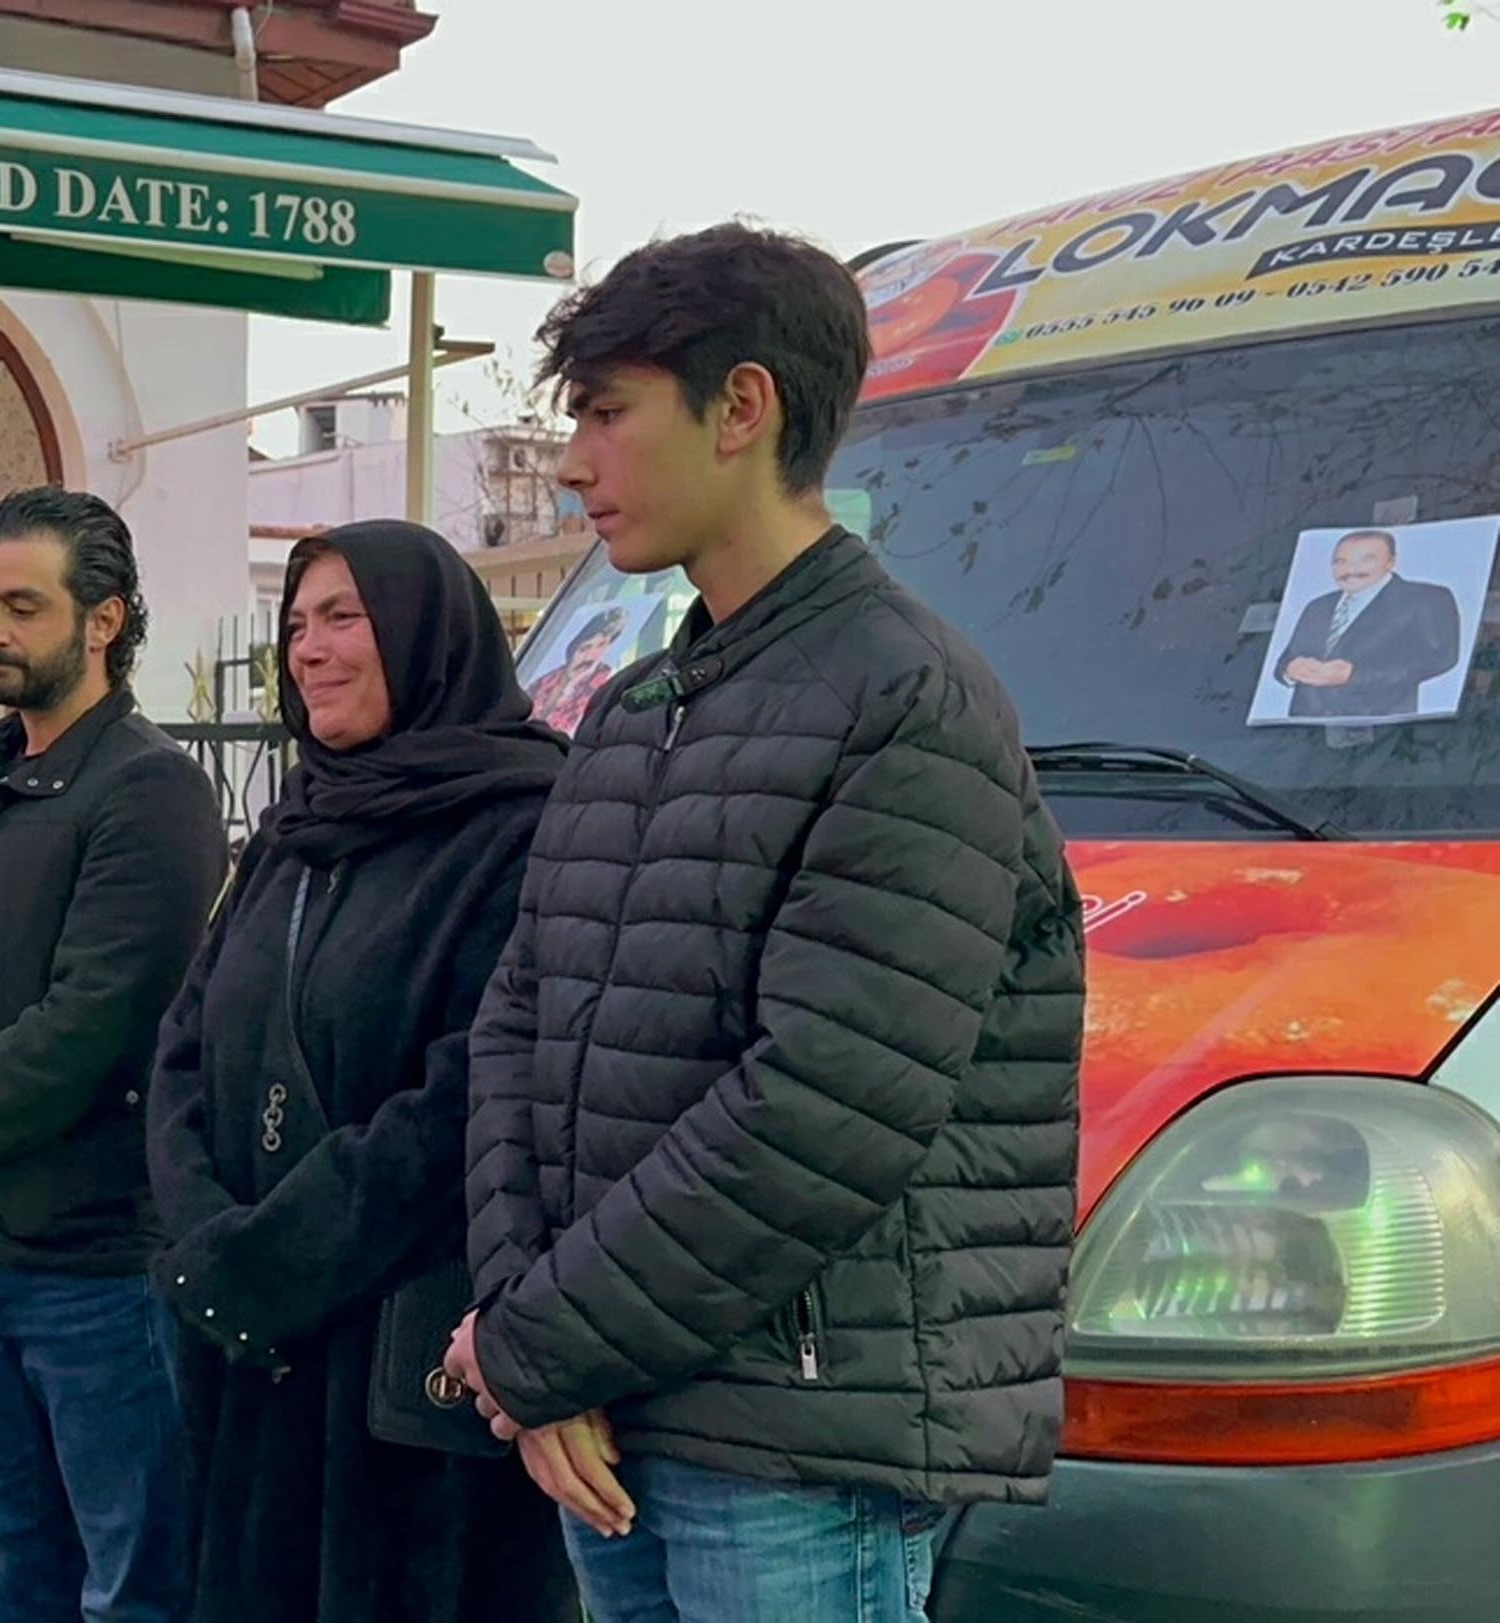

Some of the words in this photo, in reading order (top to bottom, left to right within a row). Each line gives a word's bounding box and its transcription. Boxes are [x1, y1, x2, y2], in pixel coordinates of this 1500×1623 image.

[1216, 109, 1500, 187] PASTA
[55, 168, 230, 234] DATE:
[249, 190, 357, 246] 1788
